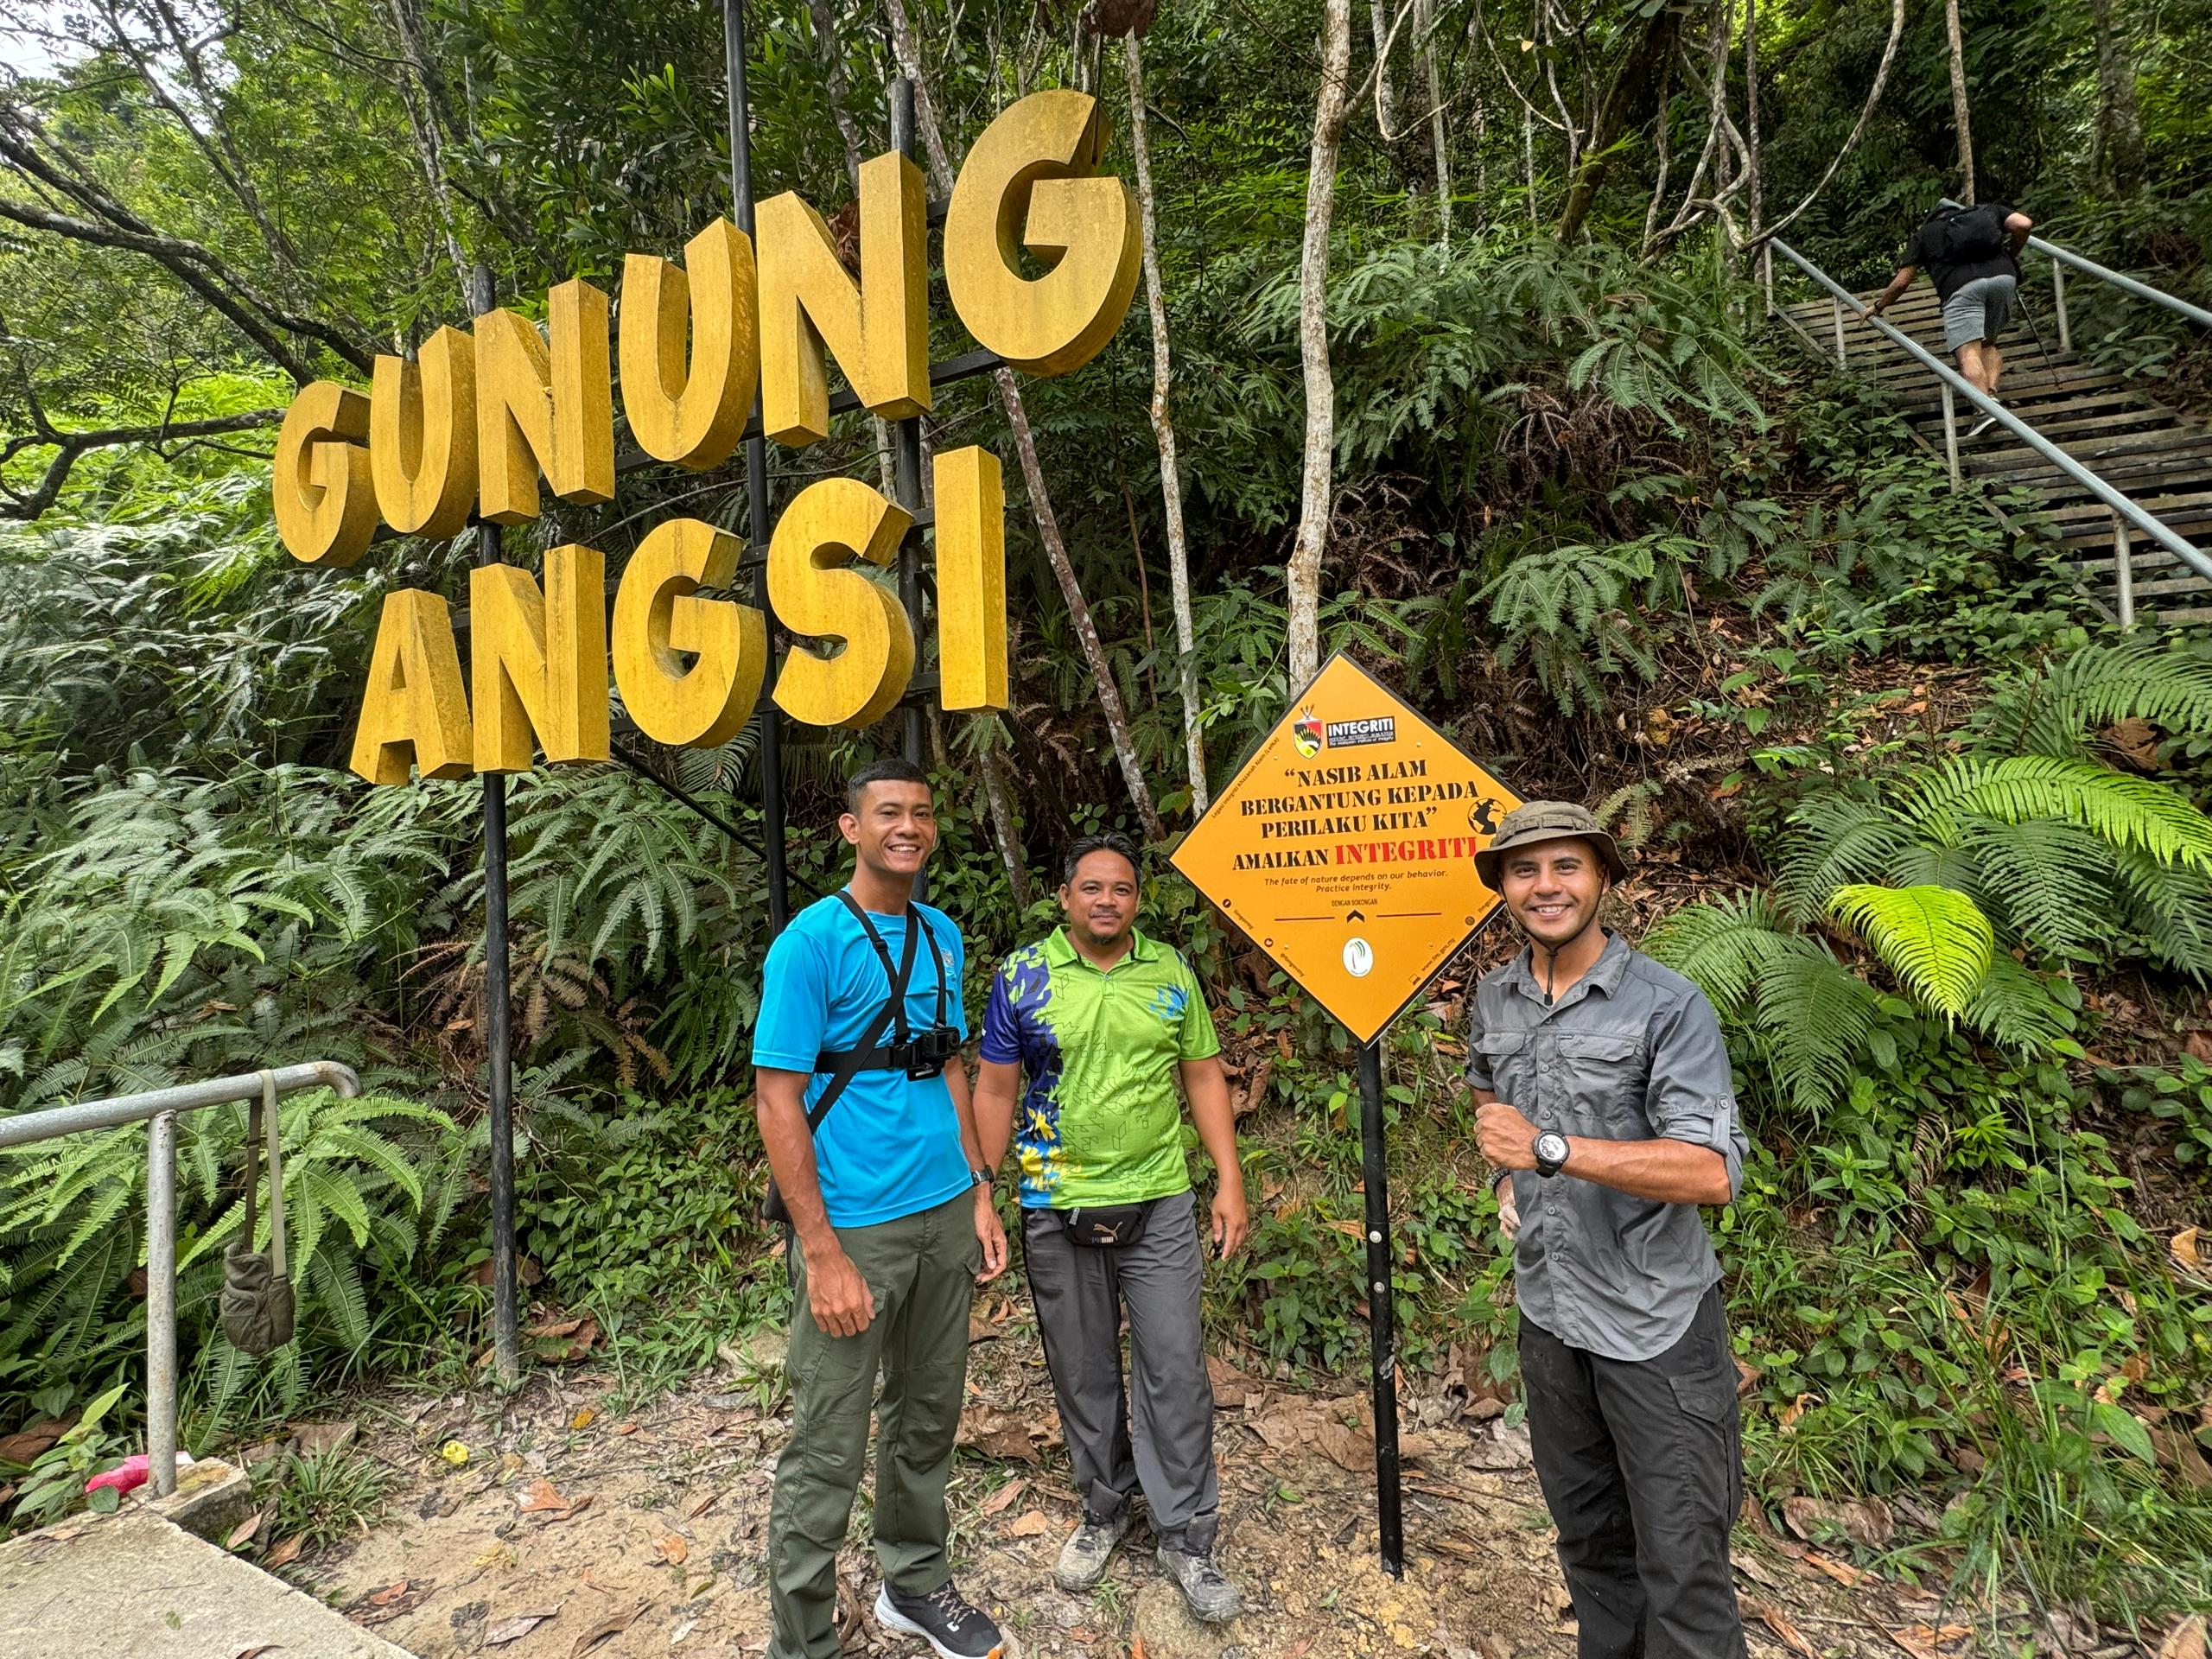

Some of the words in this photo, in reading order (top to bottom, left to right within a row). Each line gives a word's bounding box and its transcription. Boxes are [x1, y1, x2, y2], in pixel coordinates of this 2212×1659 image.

[273, 90, 1141, 567] GUNUNG
[350, 446, 1008, 785] ANGSI
[1327, 717, 1394, 737] INTEGRITI
[1285, 766, 1362, 787] “NASIB
[1366, 760, 1427, 781] ALAM
[1241, 789, 1382, 816] BERGANTUNG
[1387, 781, 1479, 804] KEPADA
[1262, 816, 1366, 838] PERILAKU
[1232, 849, 1329, 870] AMALKAN
[1335, 836, 1477, 865] INTEGRITI
[1281, 877, 1299, 887] fate
[1300, 876, 1310, 885] of
[1311, 875, 1338, 884] nature
[1339, 873, 1375, 882] depends
[1407, 869, 1448, 878] behavior.
[1315, 883, 1351, 893] Practice
[1352, 882, 1392, 892] integrity.
